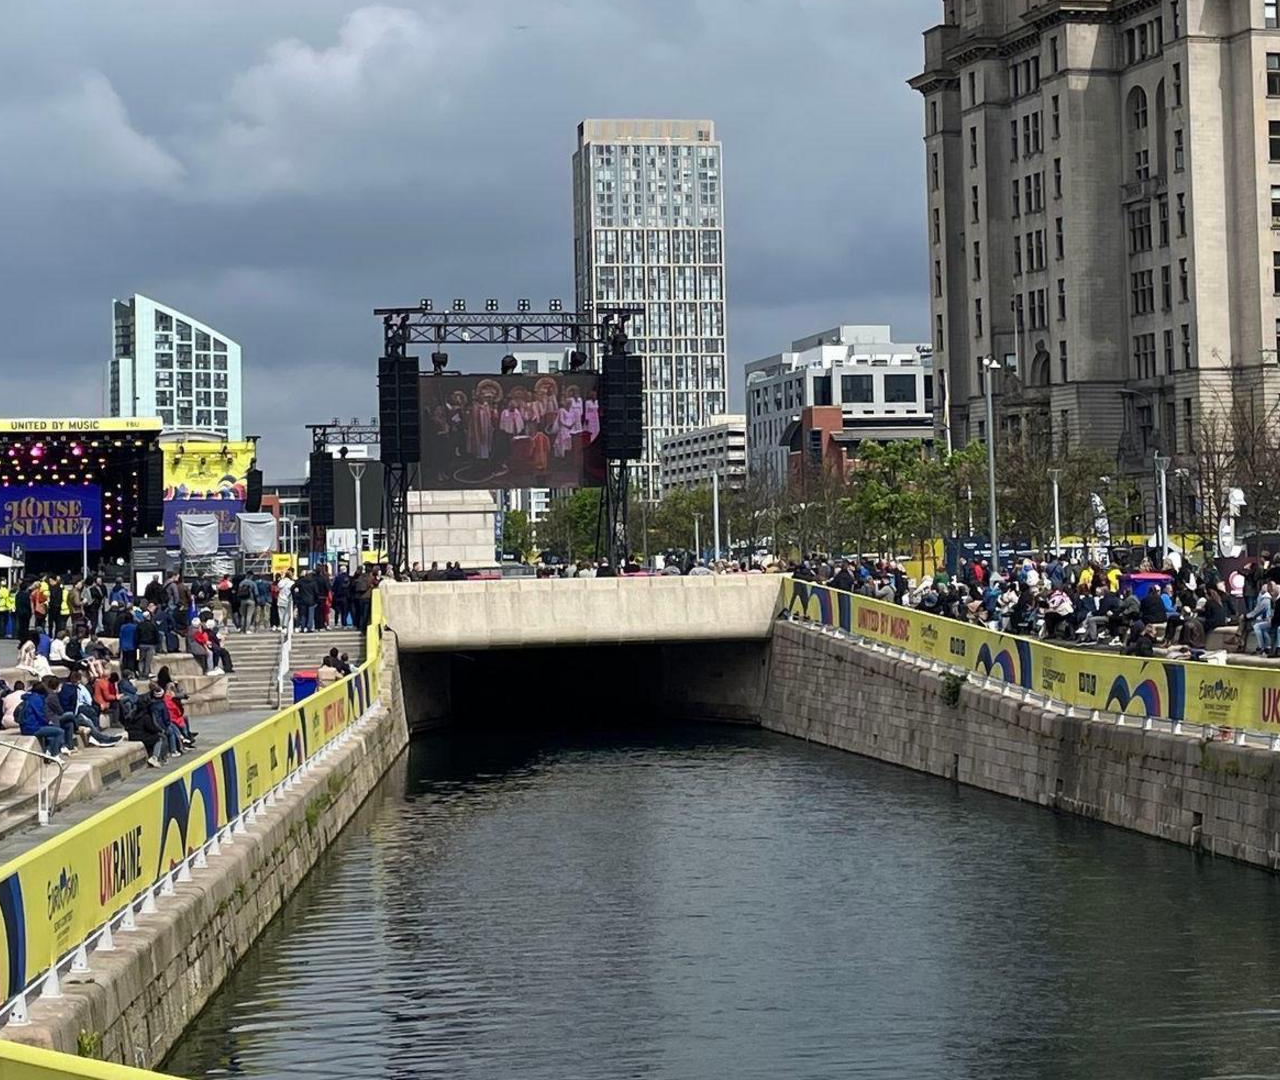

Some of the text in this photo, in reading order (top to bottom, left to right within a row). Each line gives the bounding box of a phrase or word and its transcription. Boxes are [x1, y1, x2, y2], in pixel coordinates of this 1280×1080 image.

[11, 420, 99, 430] UNITED BY MUSIC
[4, 497, 82, 521] HOUSE
[12, 517, 92, 536] SUAREZ
[98, 825, 141, 906] UKRAINE
